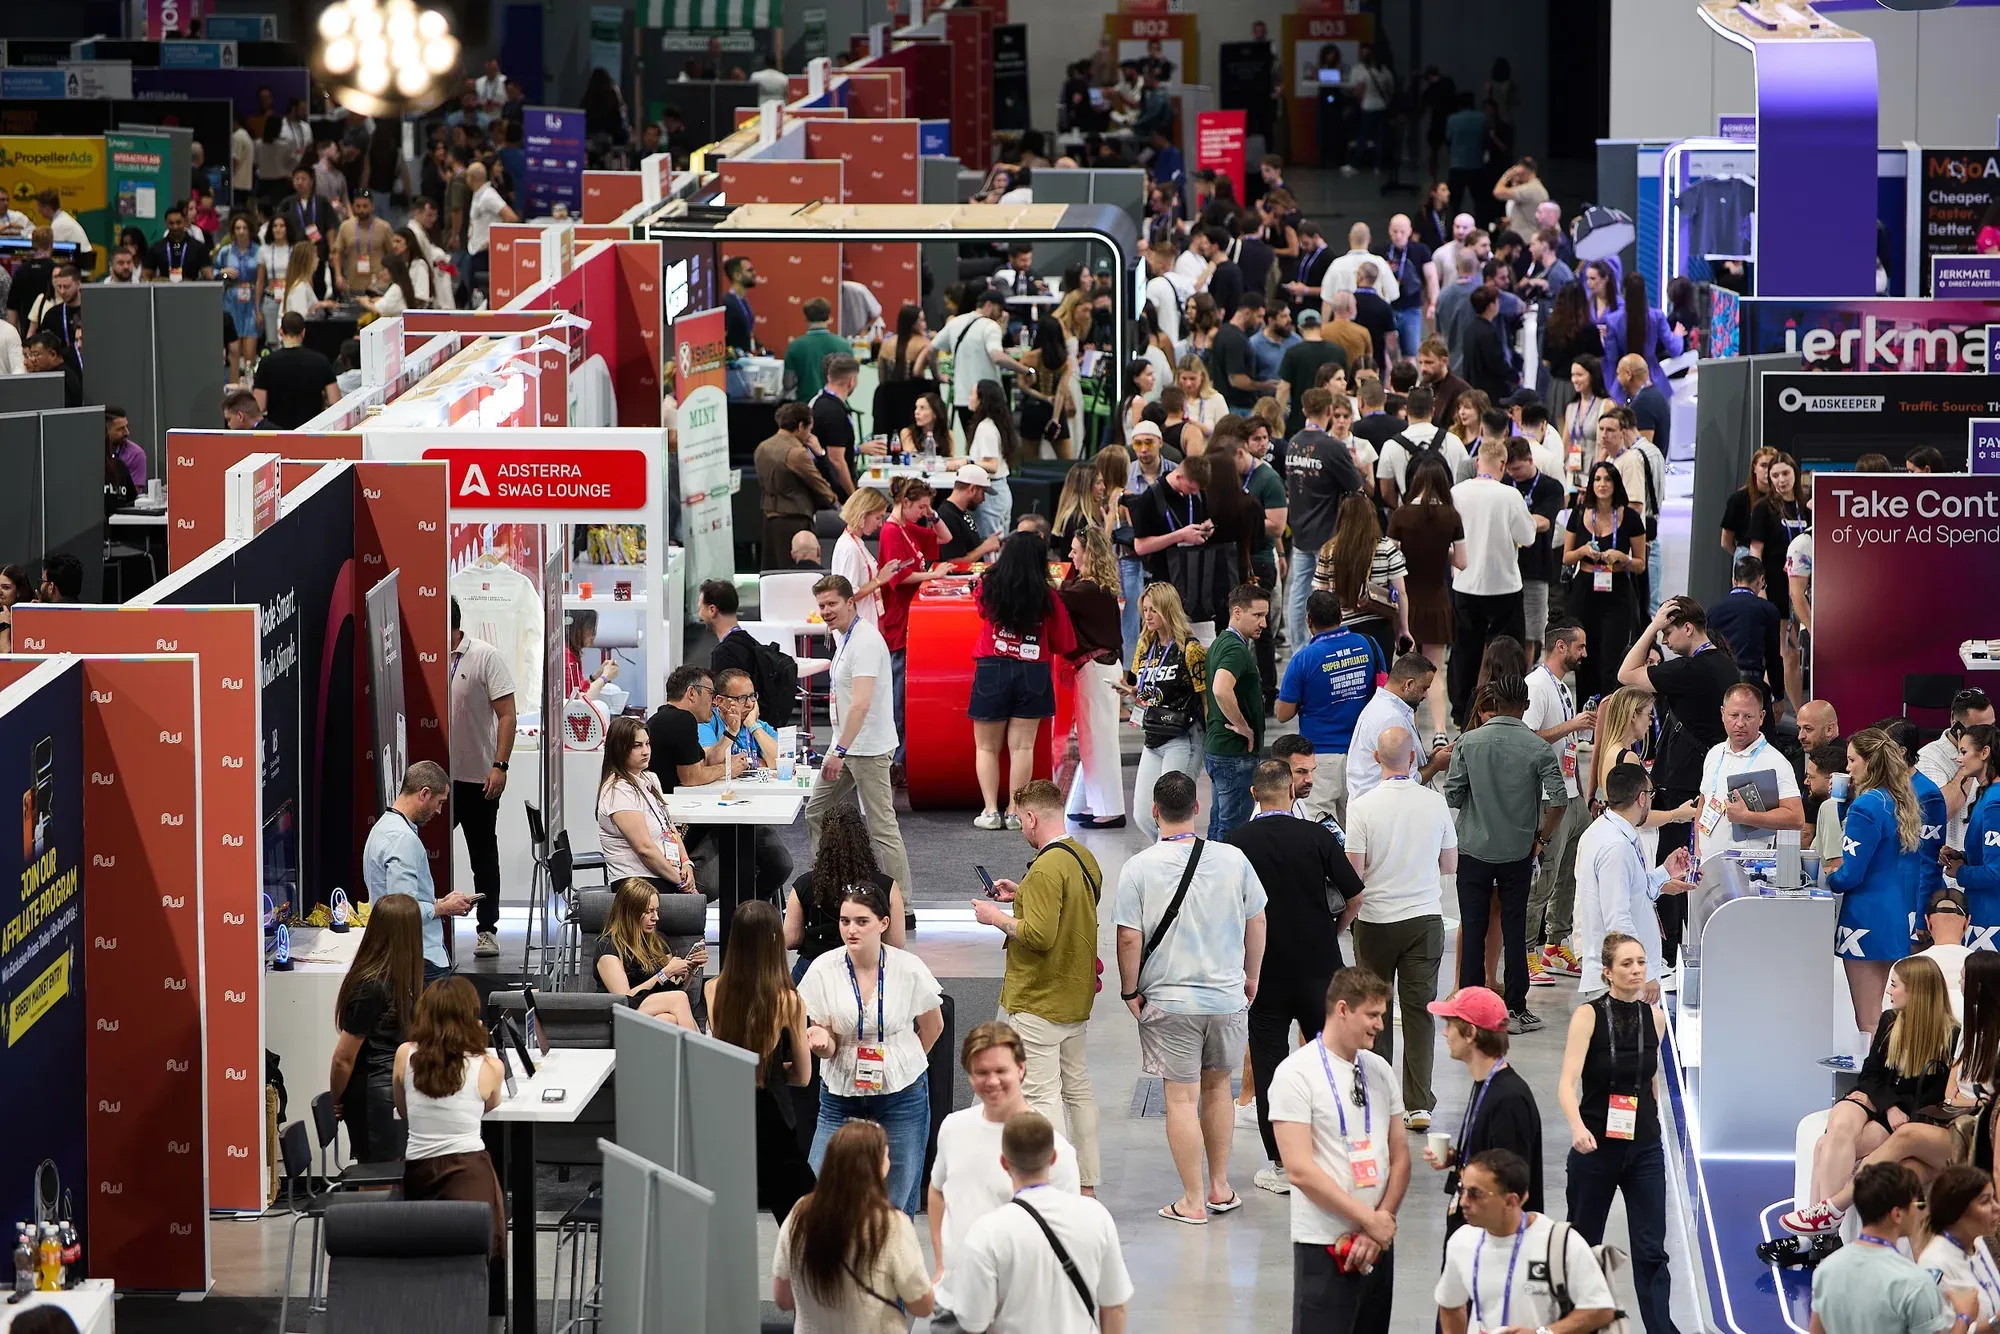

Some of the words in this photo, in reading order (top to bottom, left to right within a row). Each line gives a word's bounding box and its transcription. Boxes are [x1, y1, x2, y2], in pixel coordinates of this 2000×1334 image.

[1132, 19, 1169, 36] B02
[1309, 20, 1347, 36] B03
[14, 151, 92, 165] PropellerAds
[1928, 189, 1993, 207] Cheaper.
[1928, 222, 1975, 236] Better.
[1939, 269, 1991, 280] JERKMATE
[1811, 398, 1877, 410] ADSKEEPER
[1899, 401, 1938, 412] Traffic
[1942, 402, 1984, 412] Source
[498, 463, 582, 477] ADSTERRA
[498, 483, 543, 497] SWAG
[547, 484, 611, 498] LOUNGE
[1832, 489, 1908, 518] Take
[1831, 525, 1852, 543] of
[1856, 529, 1901, 548] your
[1905, 526, 1931, 543] Ad
[1936, 525, 2000, 548] Spend
[1322, 660, 1340, 672] SUPER
[1340, 654, 1369, 668] AFFILIATES
[21, 858, 40, 901] JOIN
[40, 847, 56, 886] OUR
[1, 897, 40, 957] AFFILIATE
[40, 865, 77, 922] PROGRAM
[31, 976, 48, 1007] MARKET
